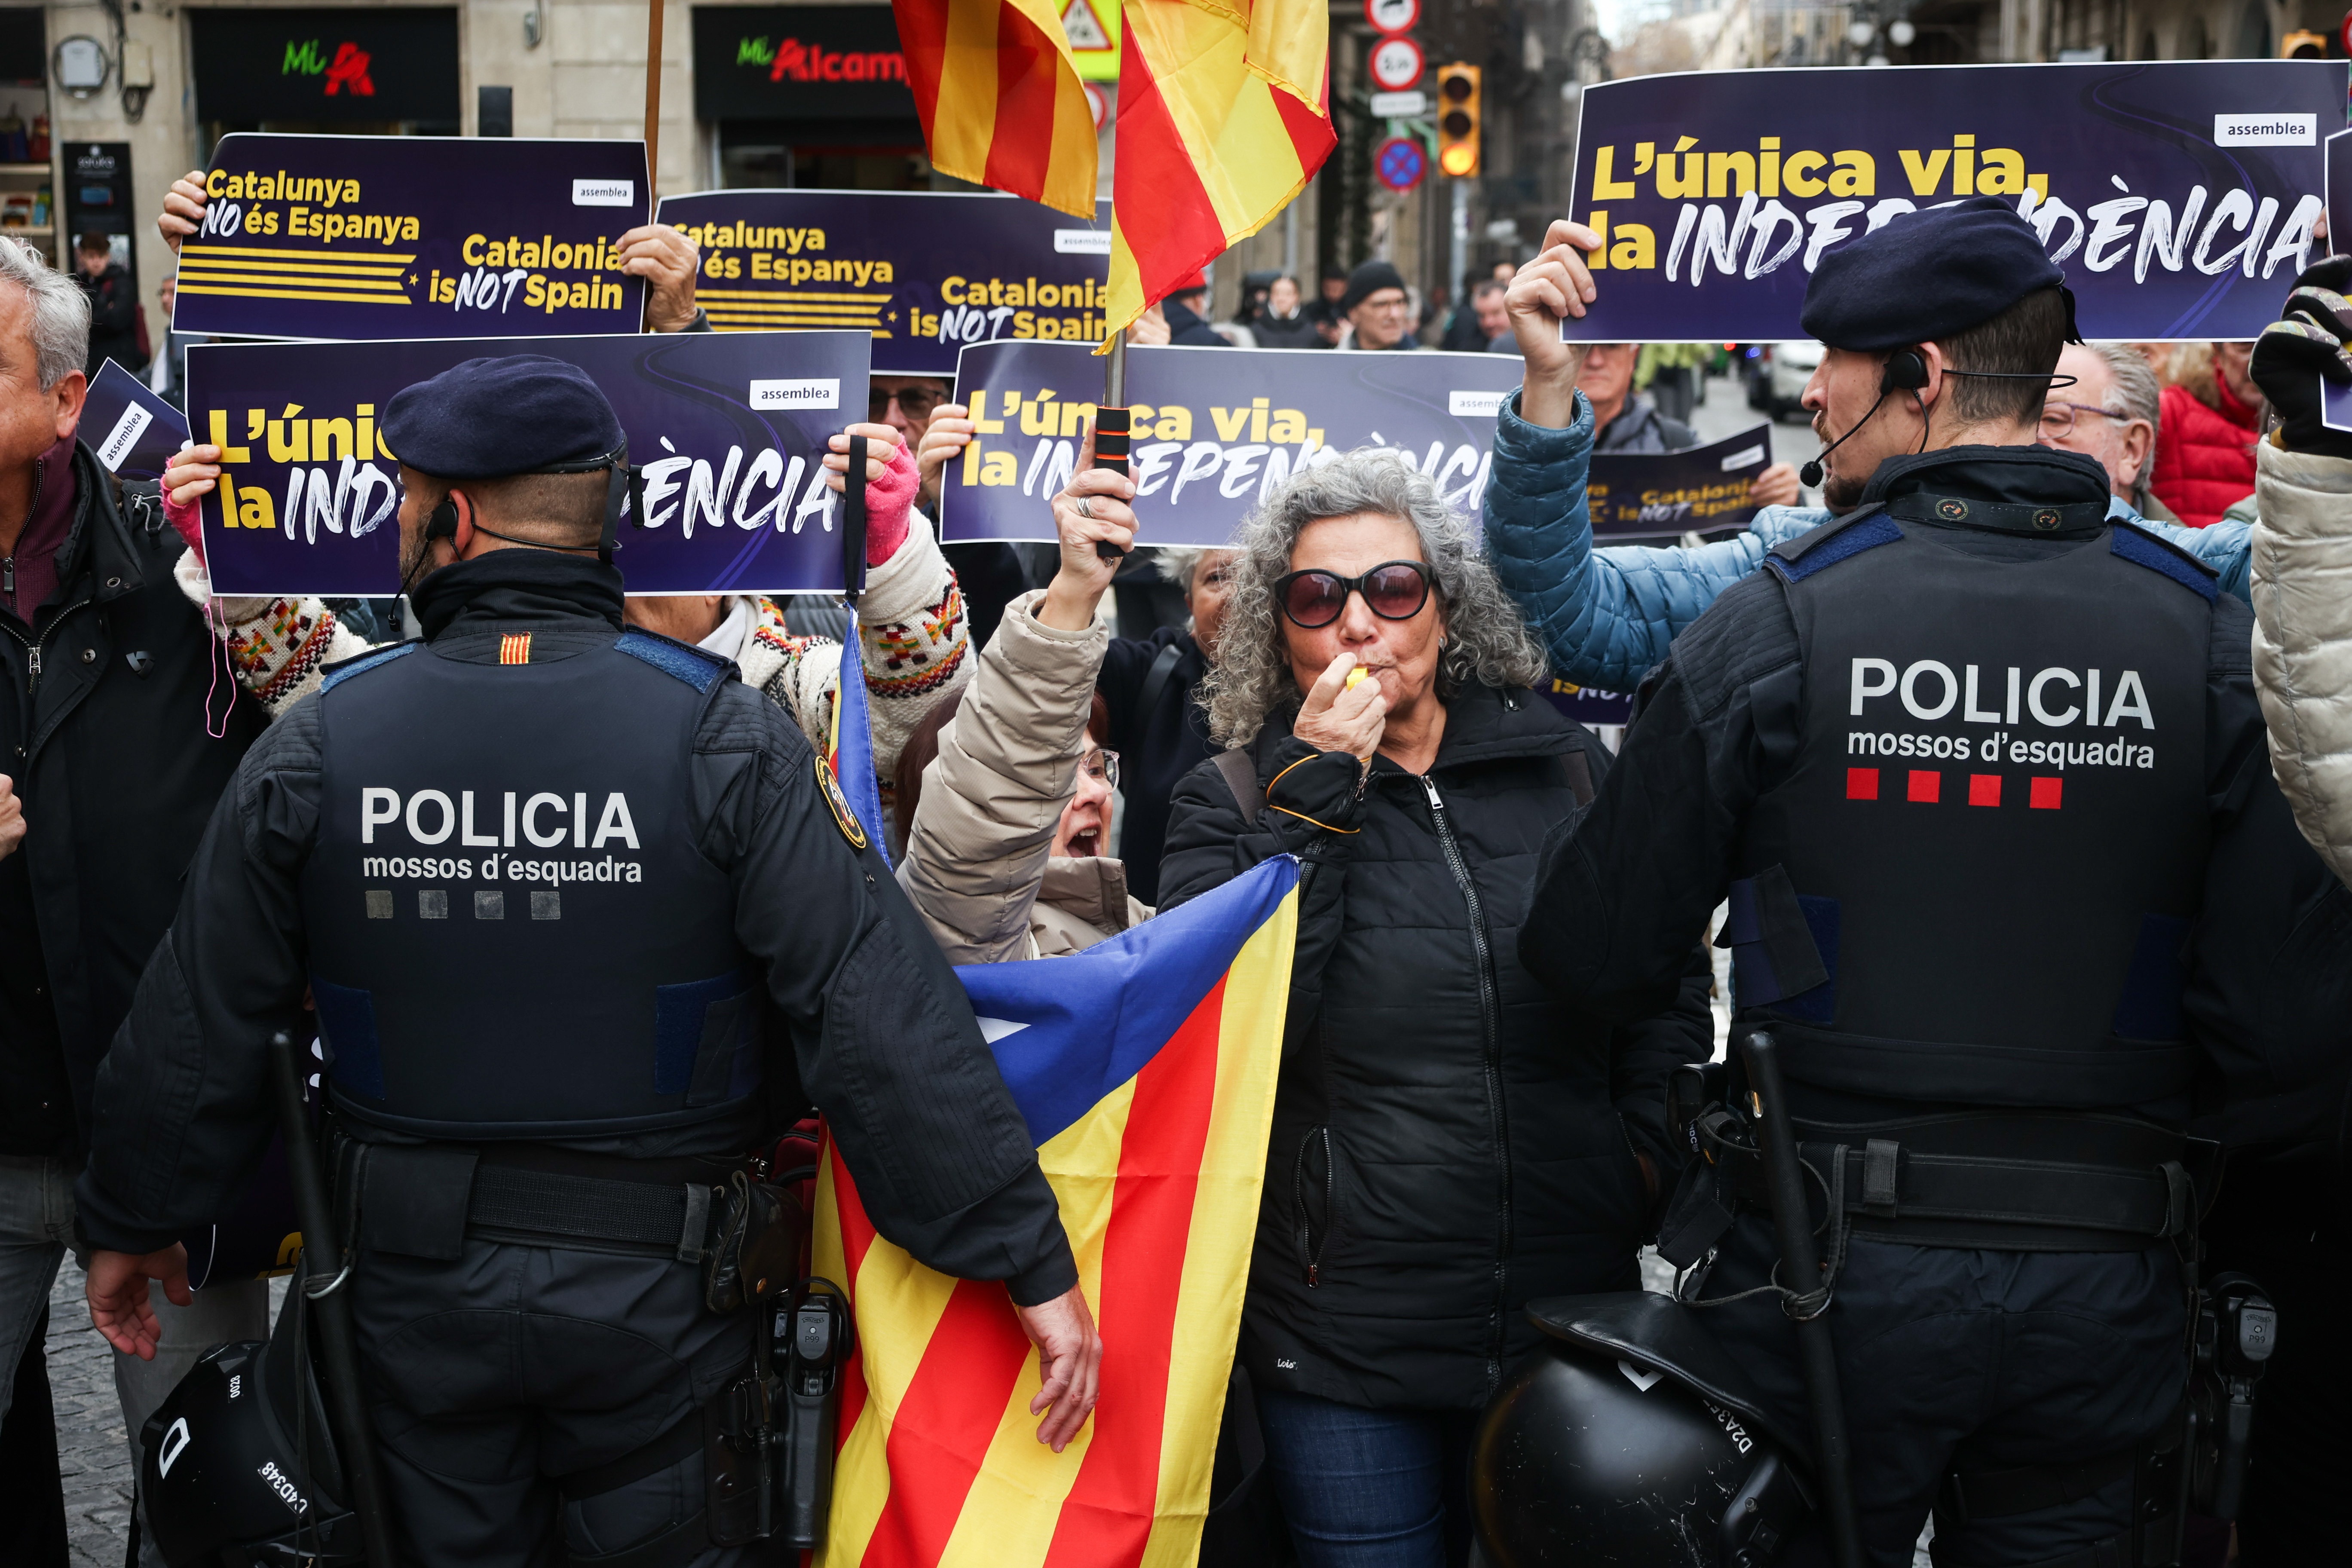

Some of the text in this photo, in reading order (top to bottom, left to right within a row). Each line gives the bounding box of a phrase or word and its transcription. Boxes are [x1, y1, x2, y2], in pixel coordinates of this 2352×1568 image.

[770, 37, 910, 88] Alcam
[2228, 122, 2306, 136] assemblea
[206, 169, 361, 208] Catalunya
[580, 186, 628, 197] assemblea
[1592, 134, 2049, 207] L'única via,
[200, 198, 420, 246] NO és Espanya
[674, 220, 826, 254] atalunya
[1588, 210, 1656, 270] la
[704, 249, 741, 279] és
[751, 253, 894, 287] Espanya
[429, 266, 624, 314] is NOT Spain
[910, 307, 939, 337] is
[939, 304, 1015, 344] NOT
[761, 387, 830, 399] assemblea
[106, 411, 143, 463] assemblea
[209, 402, 398, 463] L'úni
[967, 388, 1325, 452] L'únca via,
[963, 441, 1018, 487] la
[218, 473, 276, 529] la
[1640, 478, 1756, 506] Cataloni
[1850, 658, 2155, 730] POLICIA
[1847, 731, 2155, 770] mossos d'esquadra
[361, 787, 640, 849] POLICIA
[364, 855, 472, 881] mossos
[2249, 1335, 2266, 1344] P99
[230, 1375, 240, 1398] 0028
